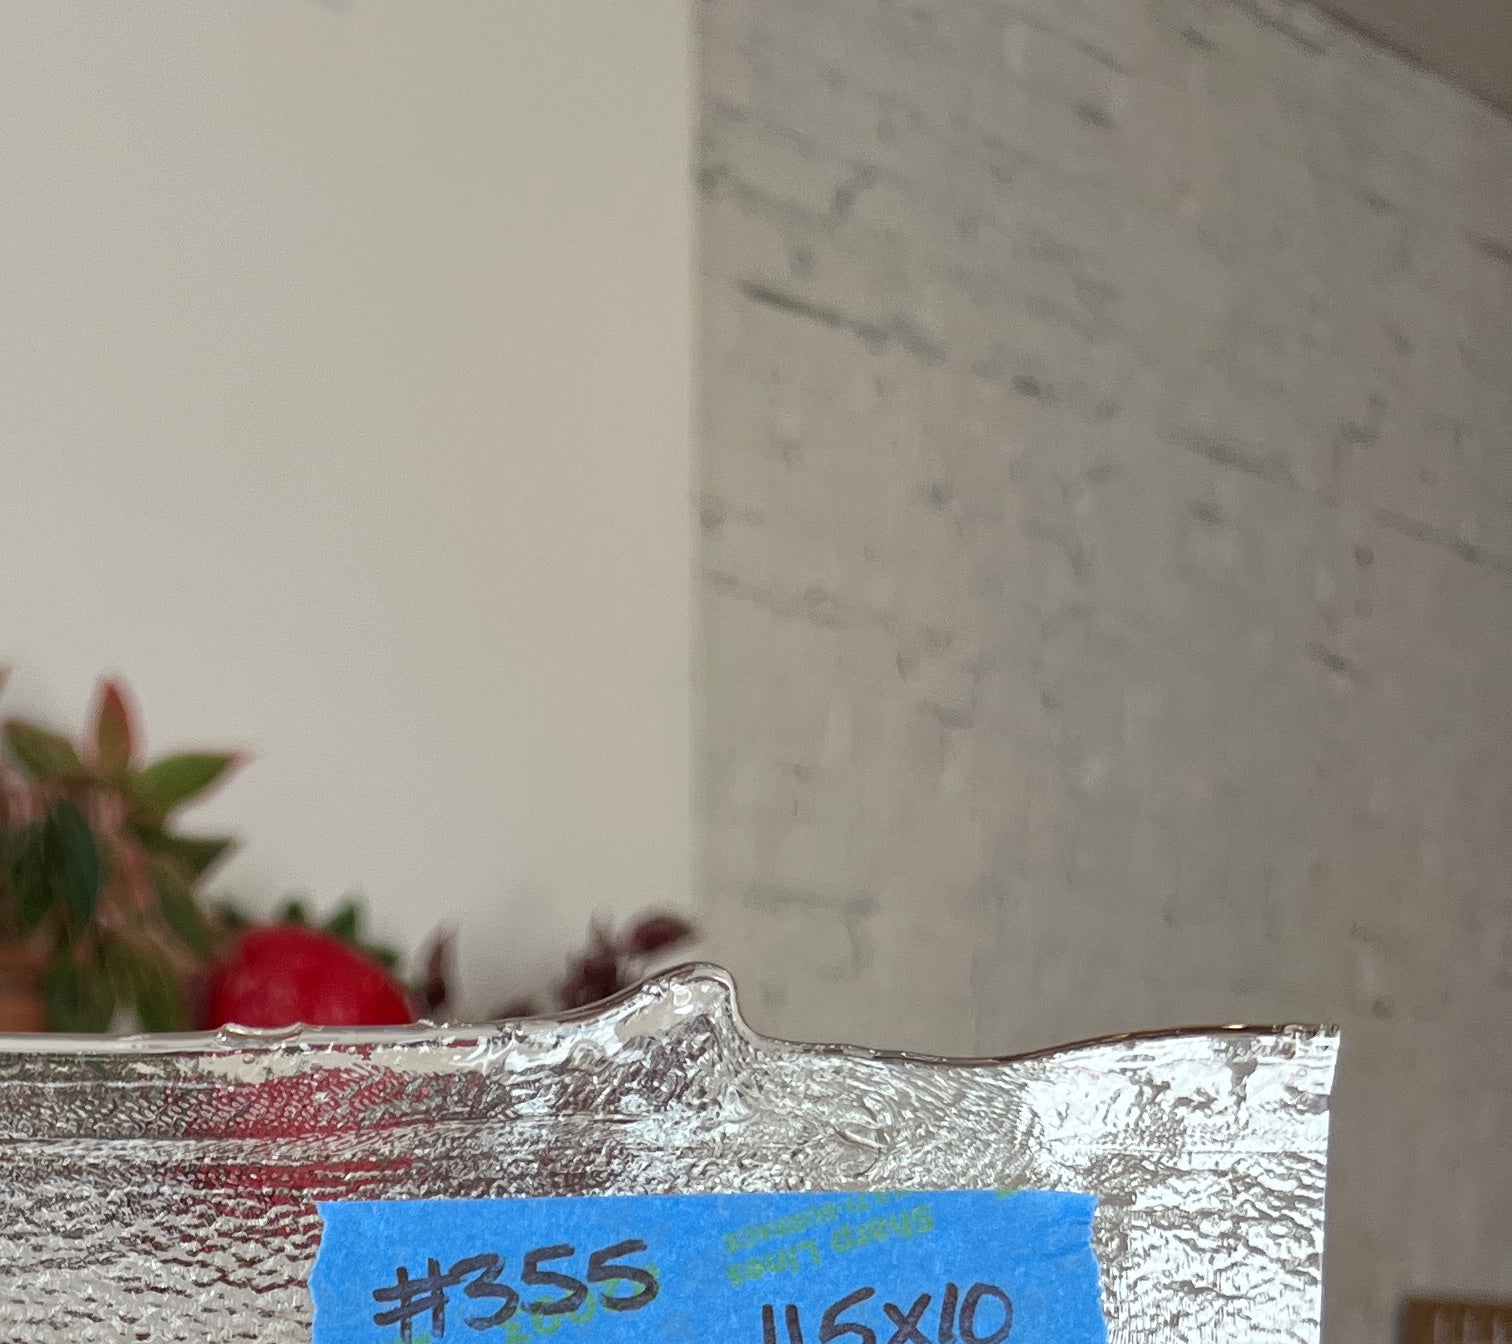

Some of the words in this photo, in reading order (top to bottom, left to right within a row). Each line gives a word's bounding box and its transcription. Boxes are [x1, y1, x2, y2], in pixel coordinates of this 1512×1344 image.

[831, 1204, 934, 1253] Sharp
[726, 1240, 821, 1287] Lines
[372, 1238, 655, 1344] #355
